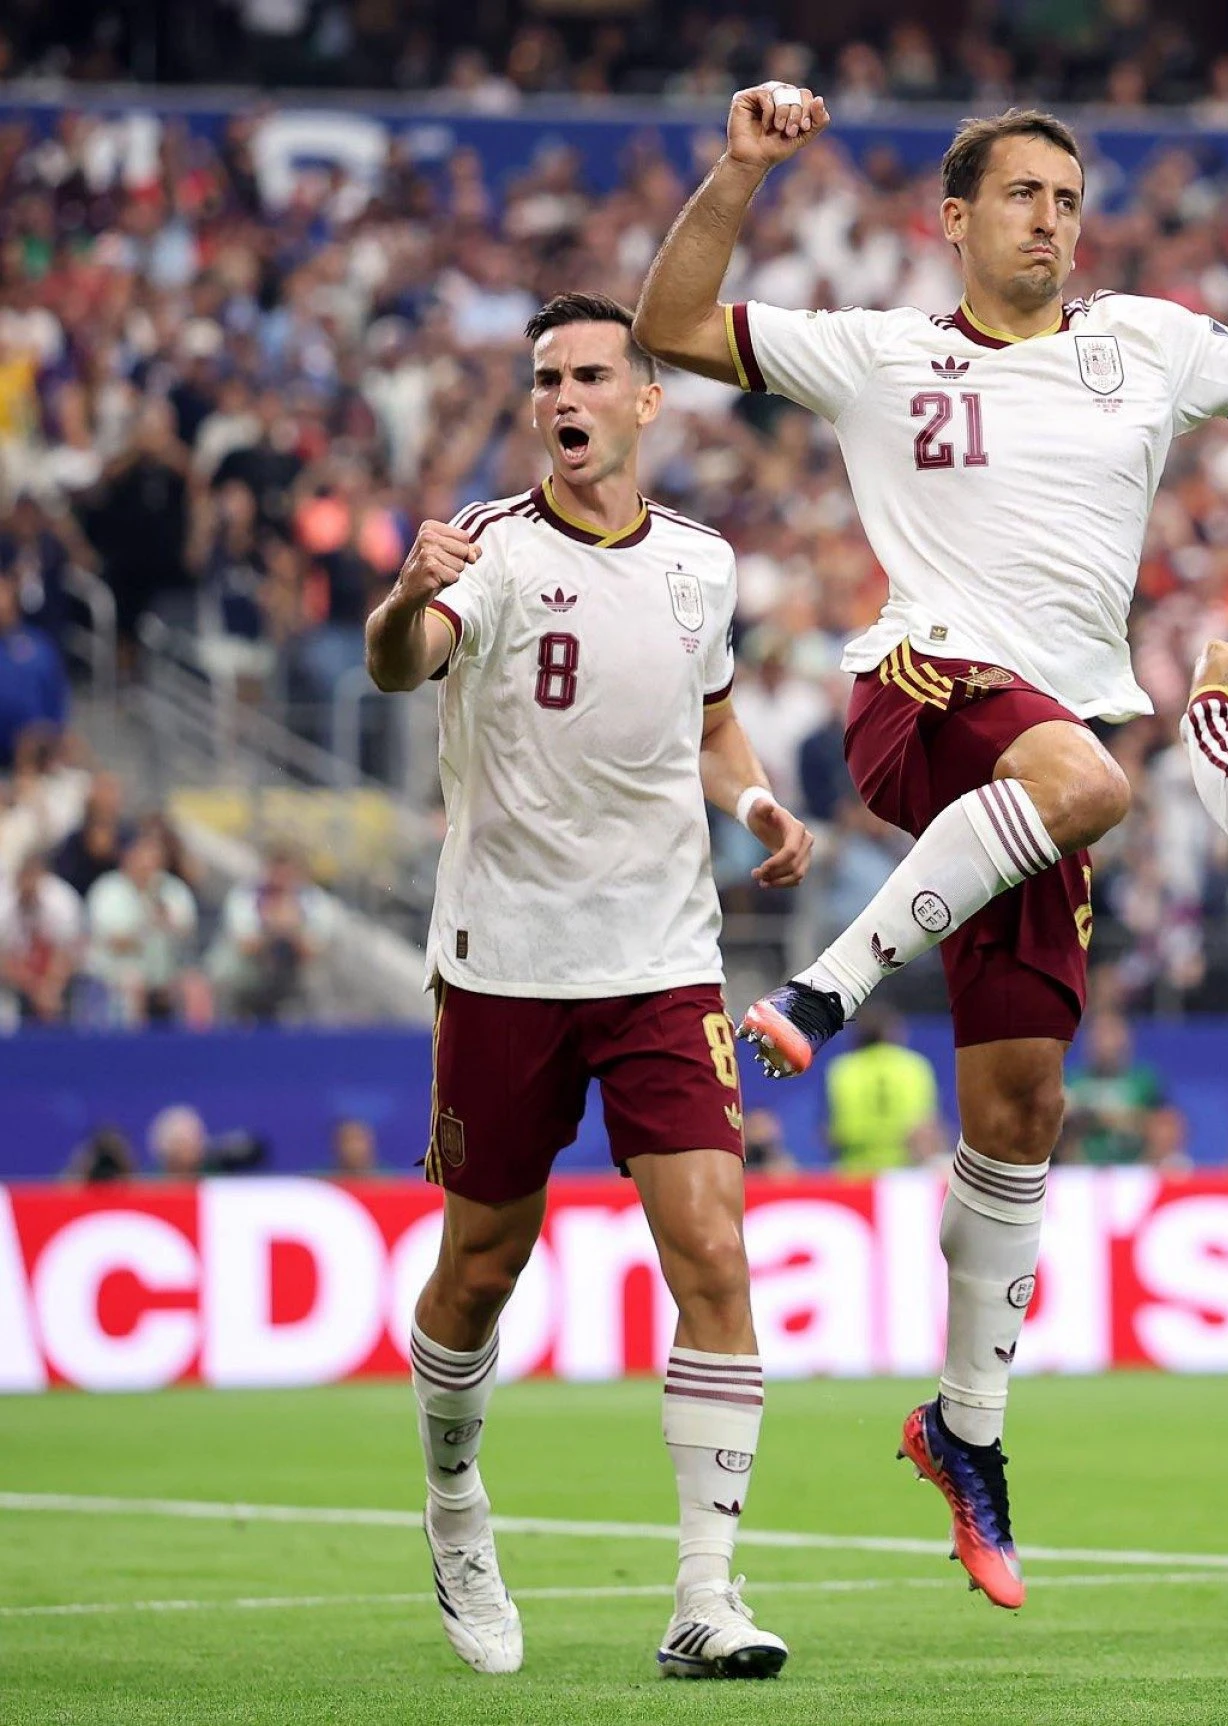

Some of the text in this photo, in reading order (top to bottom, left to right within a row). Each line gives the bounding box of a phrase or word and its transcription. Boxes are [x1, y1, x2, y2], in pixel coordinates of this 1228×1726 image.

[910, 391, 989, 470] 21
[534, 631, 580, 711] 8
[702, 1012, 738, 1089] 8
